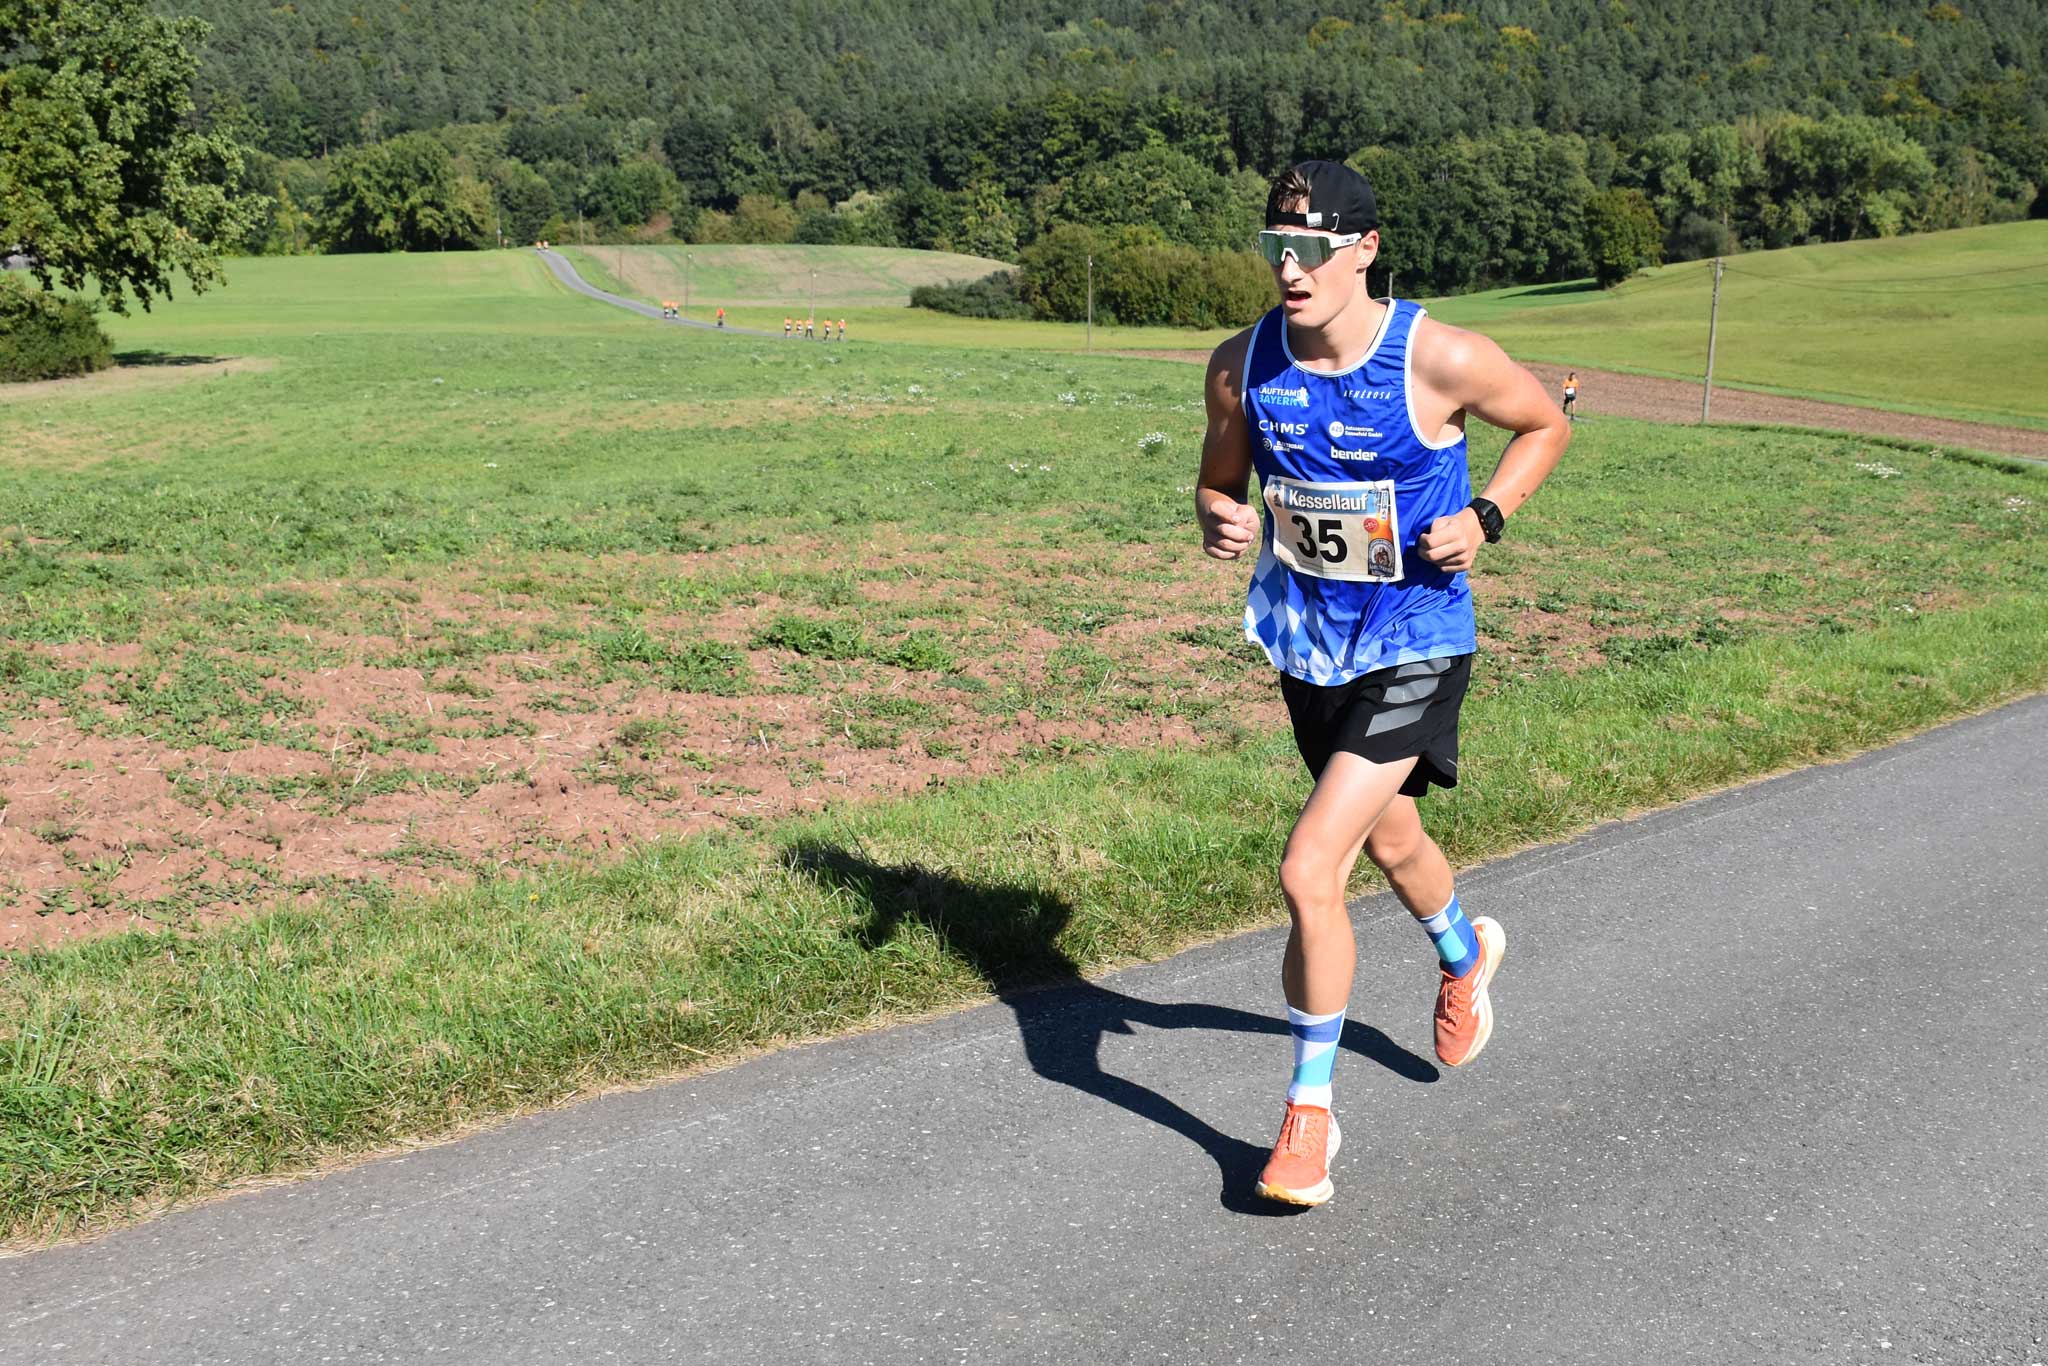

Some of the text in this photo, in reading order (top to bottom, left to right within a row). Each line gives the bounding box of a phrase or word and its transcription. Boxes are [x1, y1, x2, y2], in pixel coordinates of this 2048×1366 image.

[1259, 387, 1297, 397] LAUFTEAM
[1330, 446, 1378, 461] bender
[1288, 489, 1369, 511] Kessellauf
[1291, 514, 1348, 563] 35
